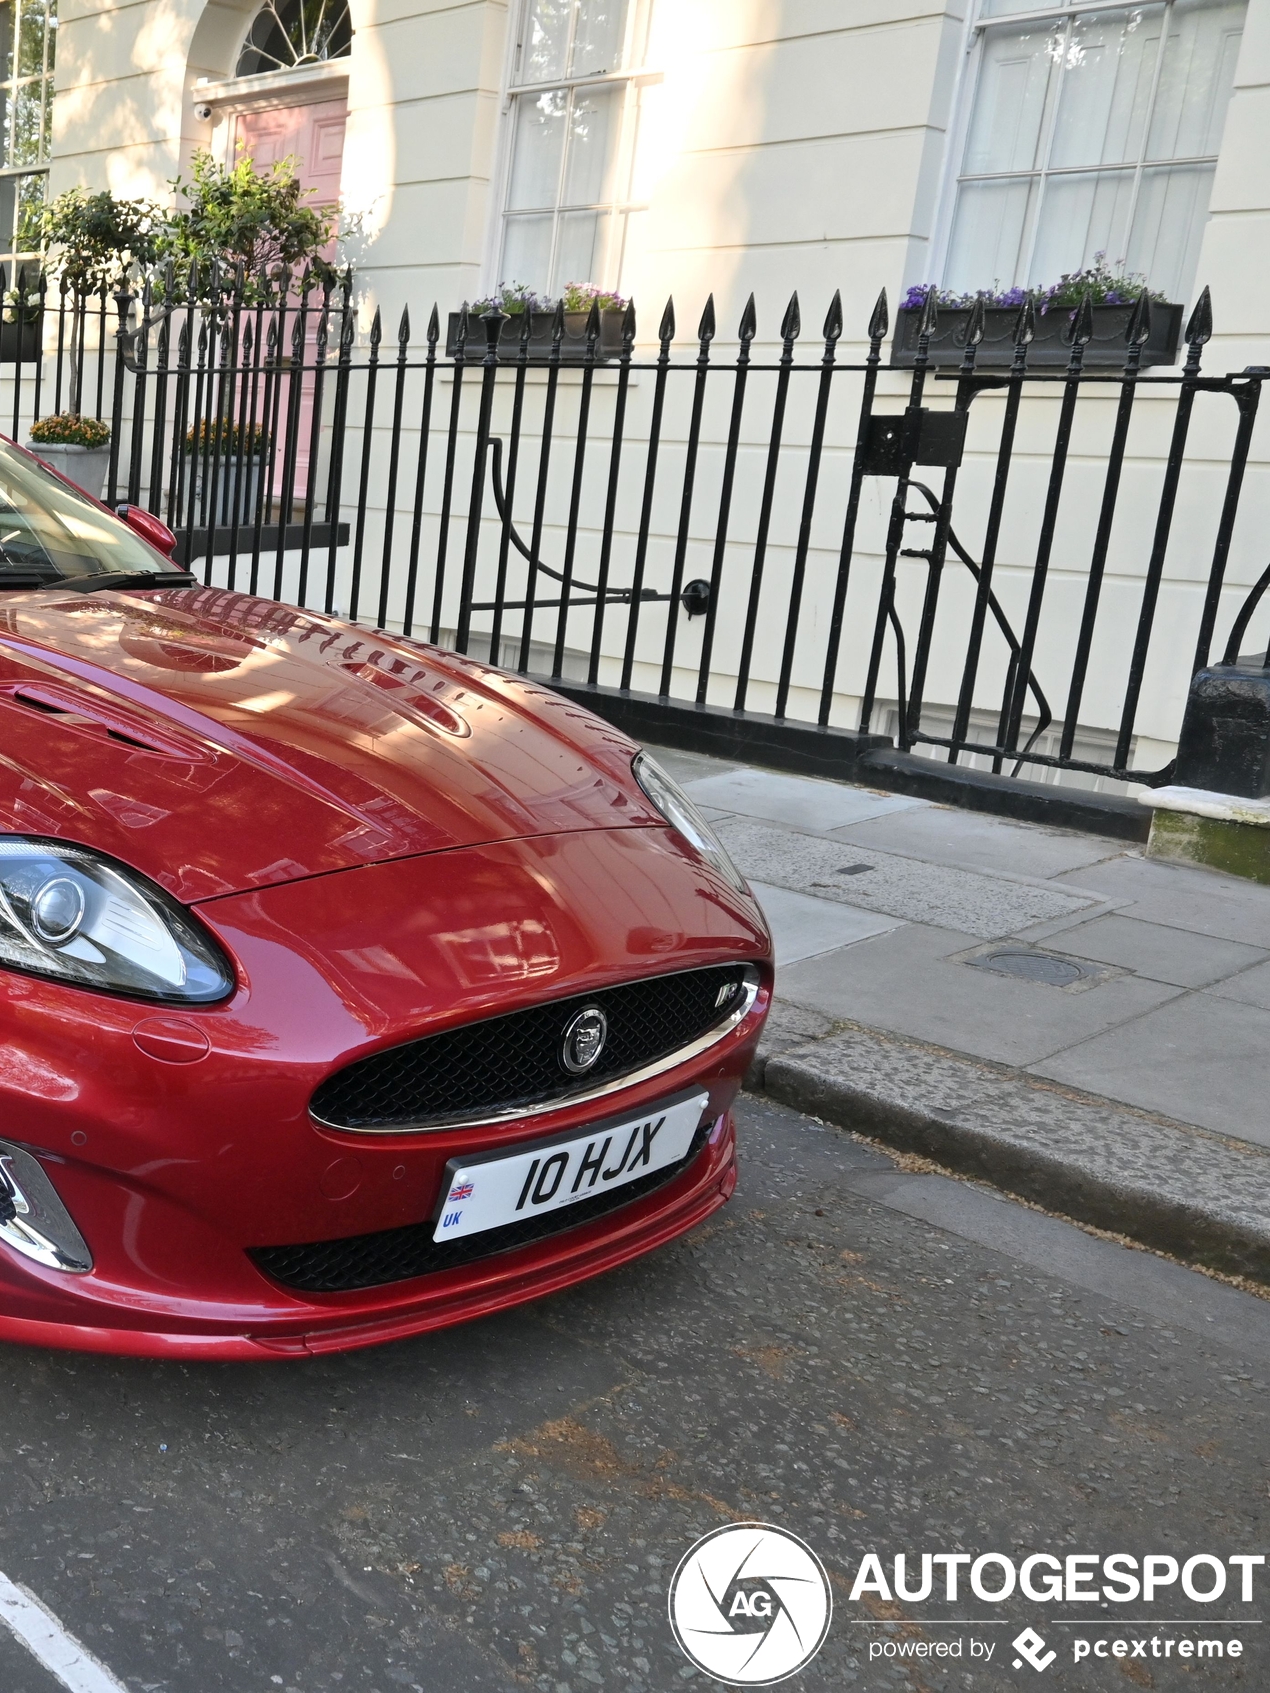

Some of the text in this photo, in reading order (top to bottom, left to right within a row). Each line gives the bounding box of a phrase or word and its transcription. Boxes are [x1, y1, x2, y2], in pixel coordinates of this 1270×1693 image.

[515, 1116, 666, 1211] 10 HJX
[442, 1210, 463, 1229] UK
